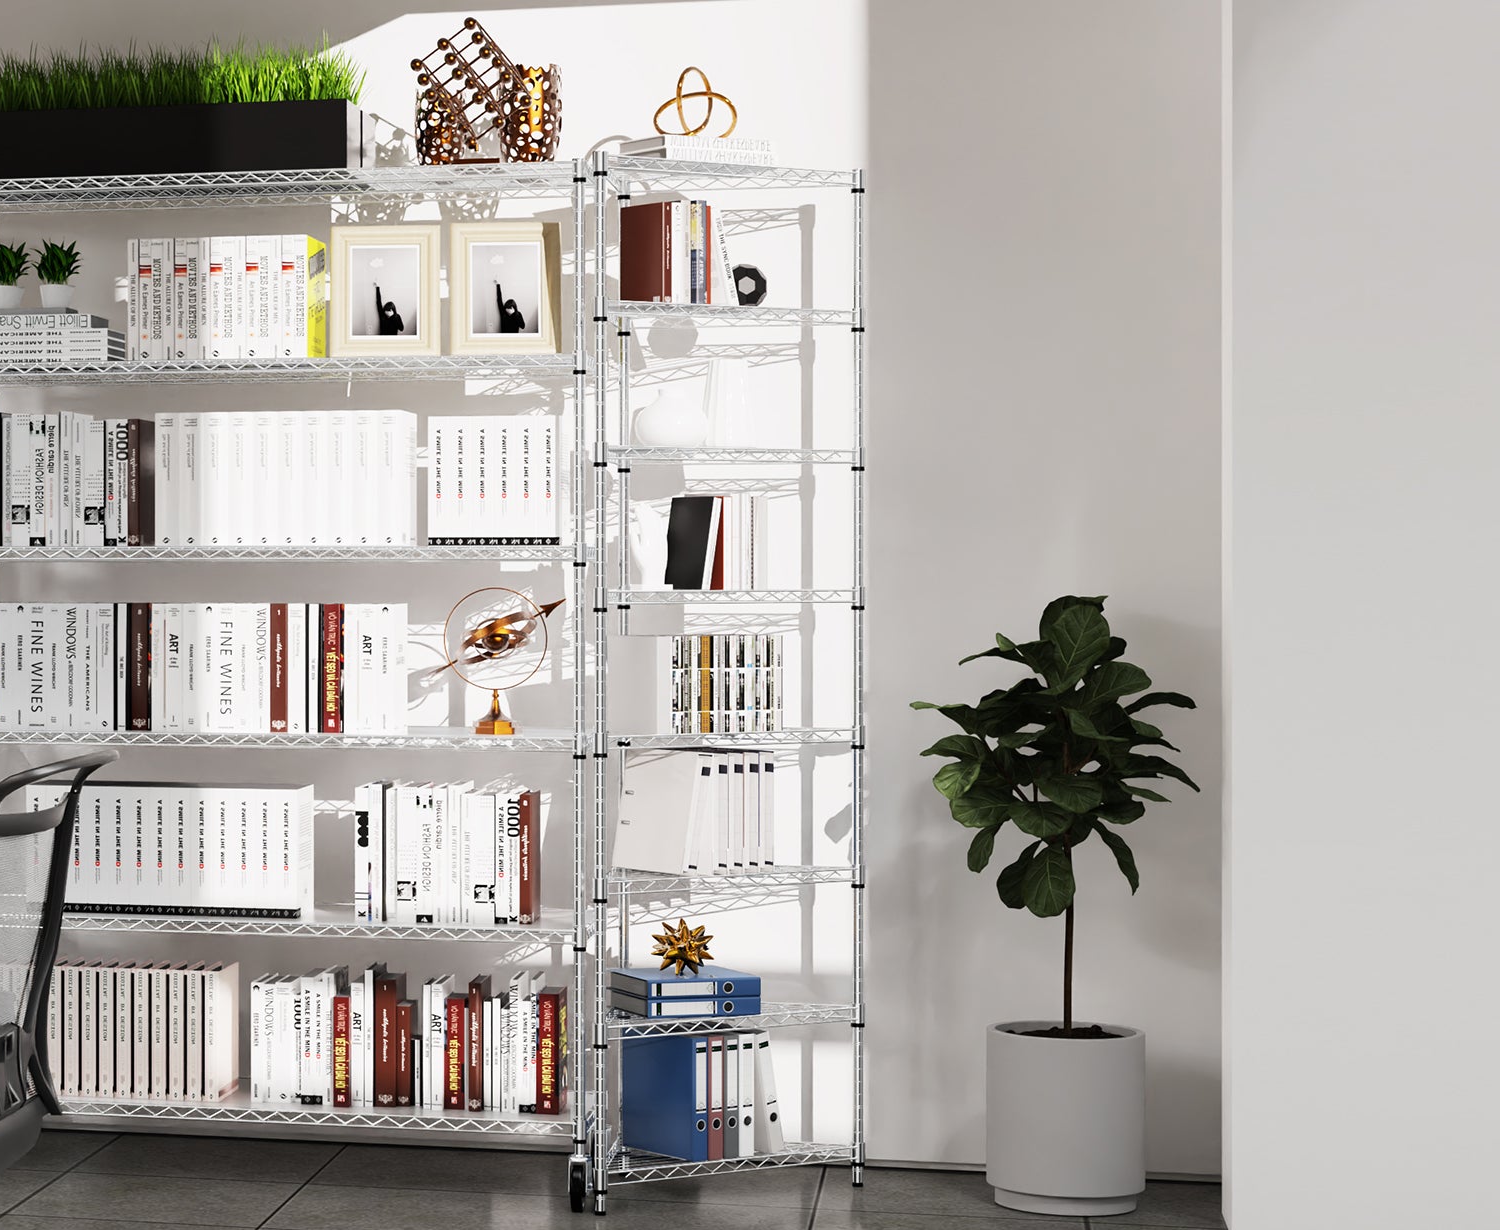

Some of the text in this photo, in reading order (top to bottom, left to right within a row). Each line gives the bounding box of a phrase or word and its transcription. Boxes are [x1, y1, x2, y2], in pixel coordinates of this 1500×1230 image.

[153, 258, 162, 288] MOVIES
[188, 257, 197, 287] MOVIES
[153, 289, 161, 304] AND
[188, 288, 197, 303] AND
[25, 314, 55, 328] Erwitt
[59, 314, 88, 328] Elliott
[66, 607, 77, 660] WINDOWS
[256, 608, 267, 661] WINDOWS
[169, 634, 179, 654] ART
[363, 635, 372, 655] ART
[31, 621, 44, 712] FINE WINES
[220, 622, 233, 715] FINE WINES
[265, 988, 274, 1036] WINDOWS
[353, 1012, 362, 1031] ART
[432, 1014, 441, 1034] ART
